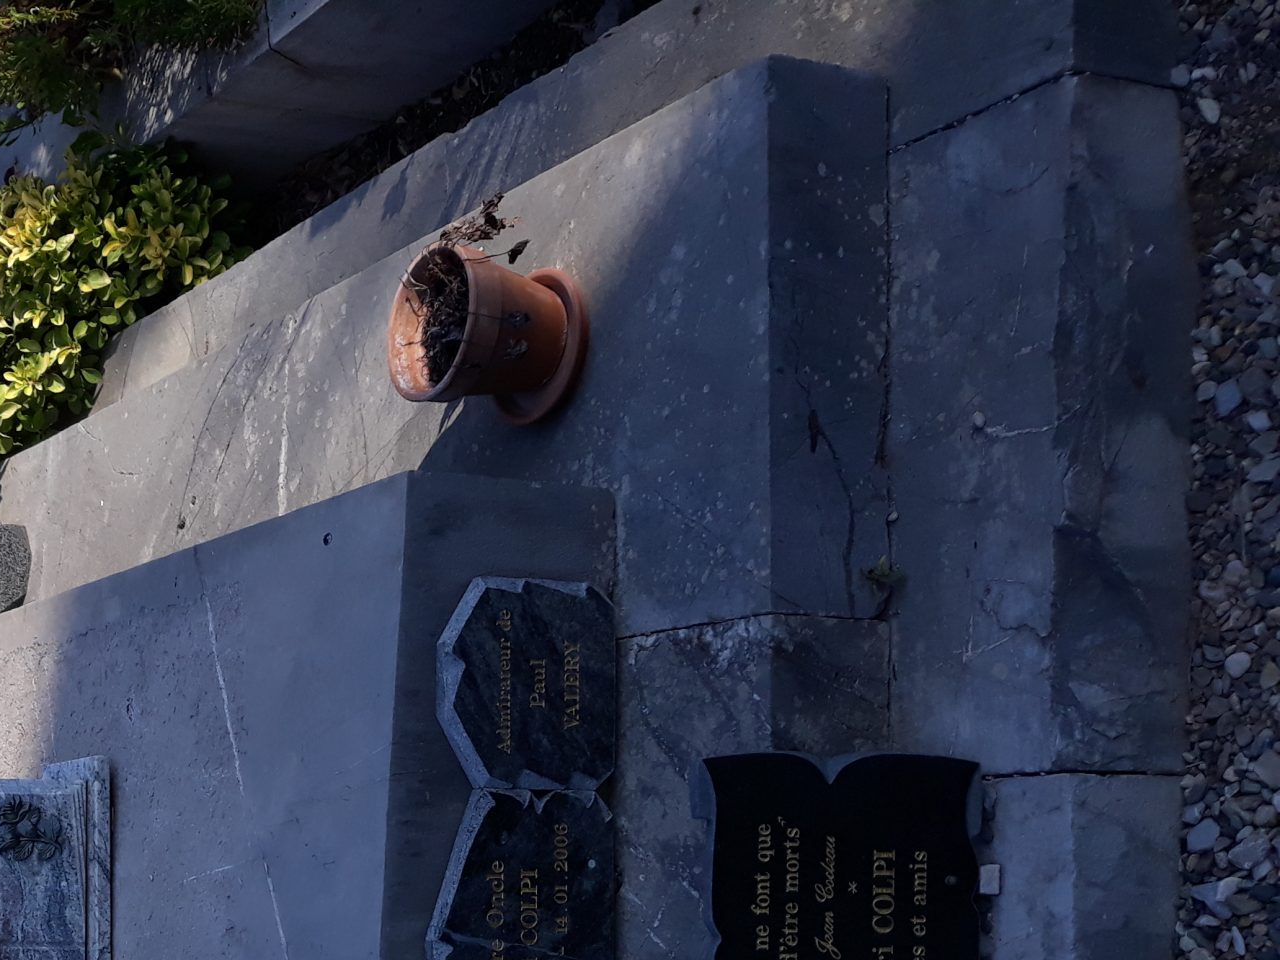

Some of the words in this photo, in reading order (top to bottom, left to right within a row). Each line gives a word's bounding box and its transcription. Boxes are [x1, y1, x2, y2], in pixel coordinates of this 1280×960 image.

[496, 608, 512, 631] de
[496, 638, 512, 754] Admirateur
[529, 658, 546, 708] Paul
[563, 640, 581, 730] VALERY
[755, 824, 775, 863] que
[814, 835, 836, 903] Cocteau
[486, 860, 505, 929] Oncle
[750, 872, 771, 916] font
[872, 849, 896, 934] COLPI
[910, 850, 928, 906] amis
[520, 868, 538, 946] COLPI
[910, 915, 926, 936] et
[754, 925, 770, 951] ne
[814, 911, 841, 960] Jean
